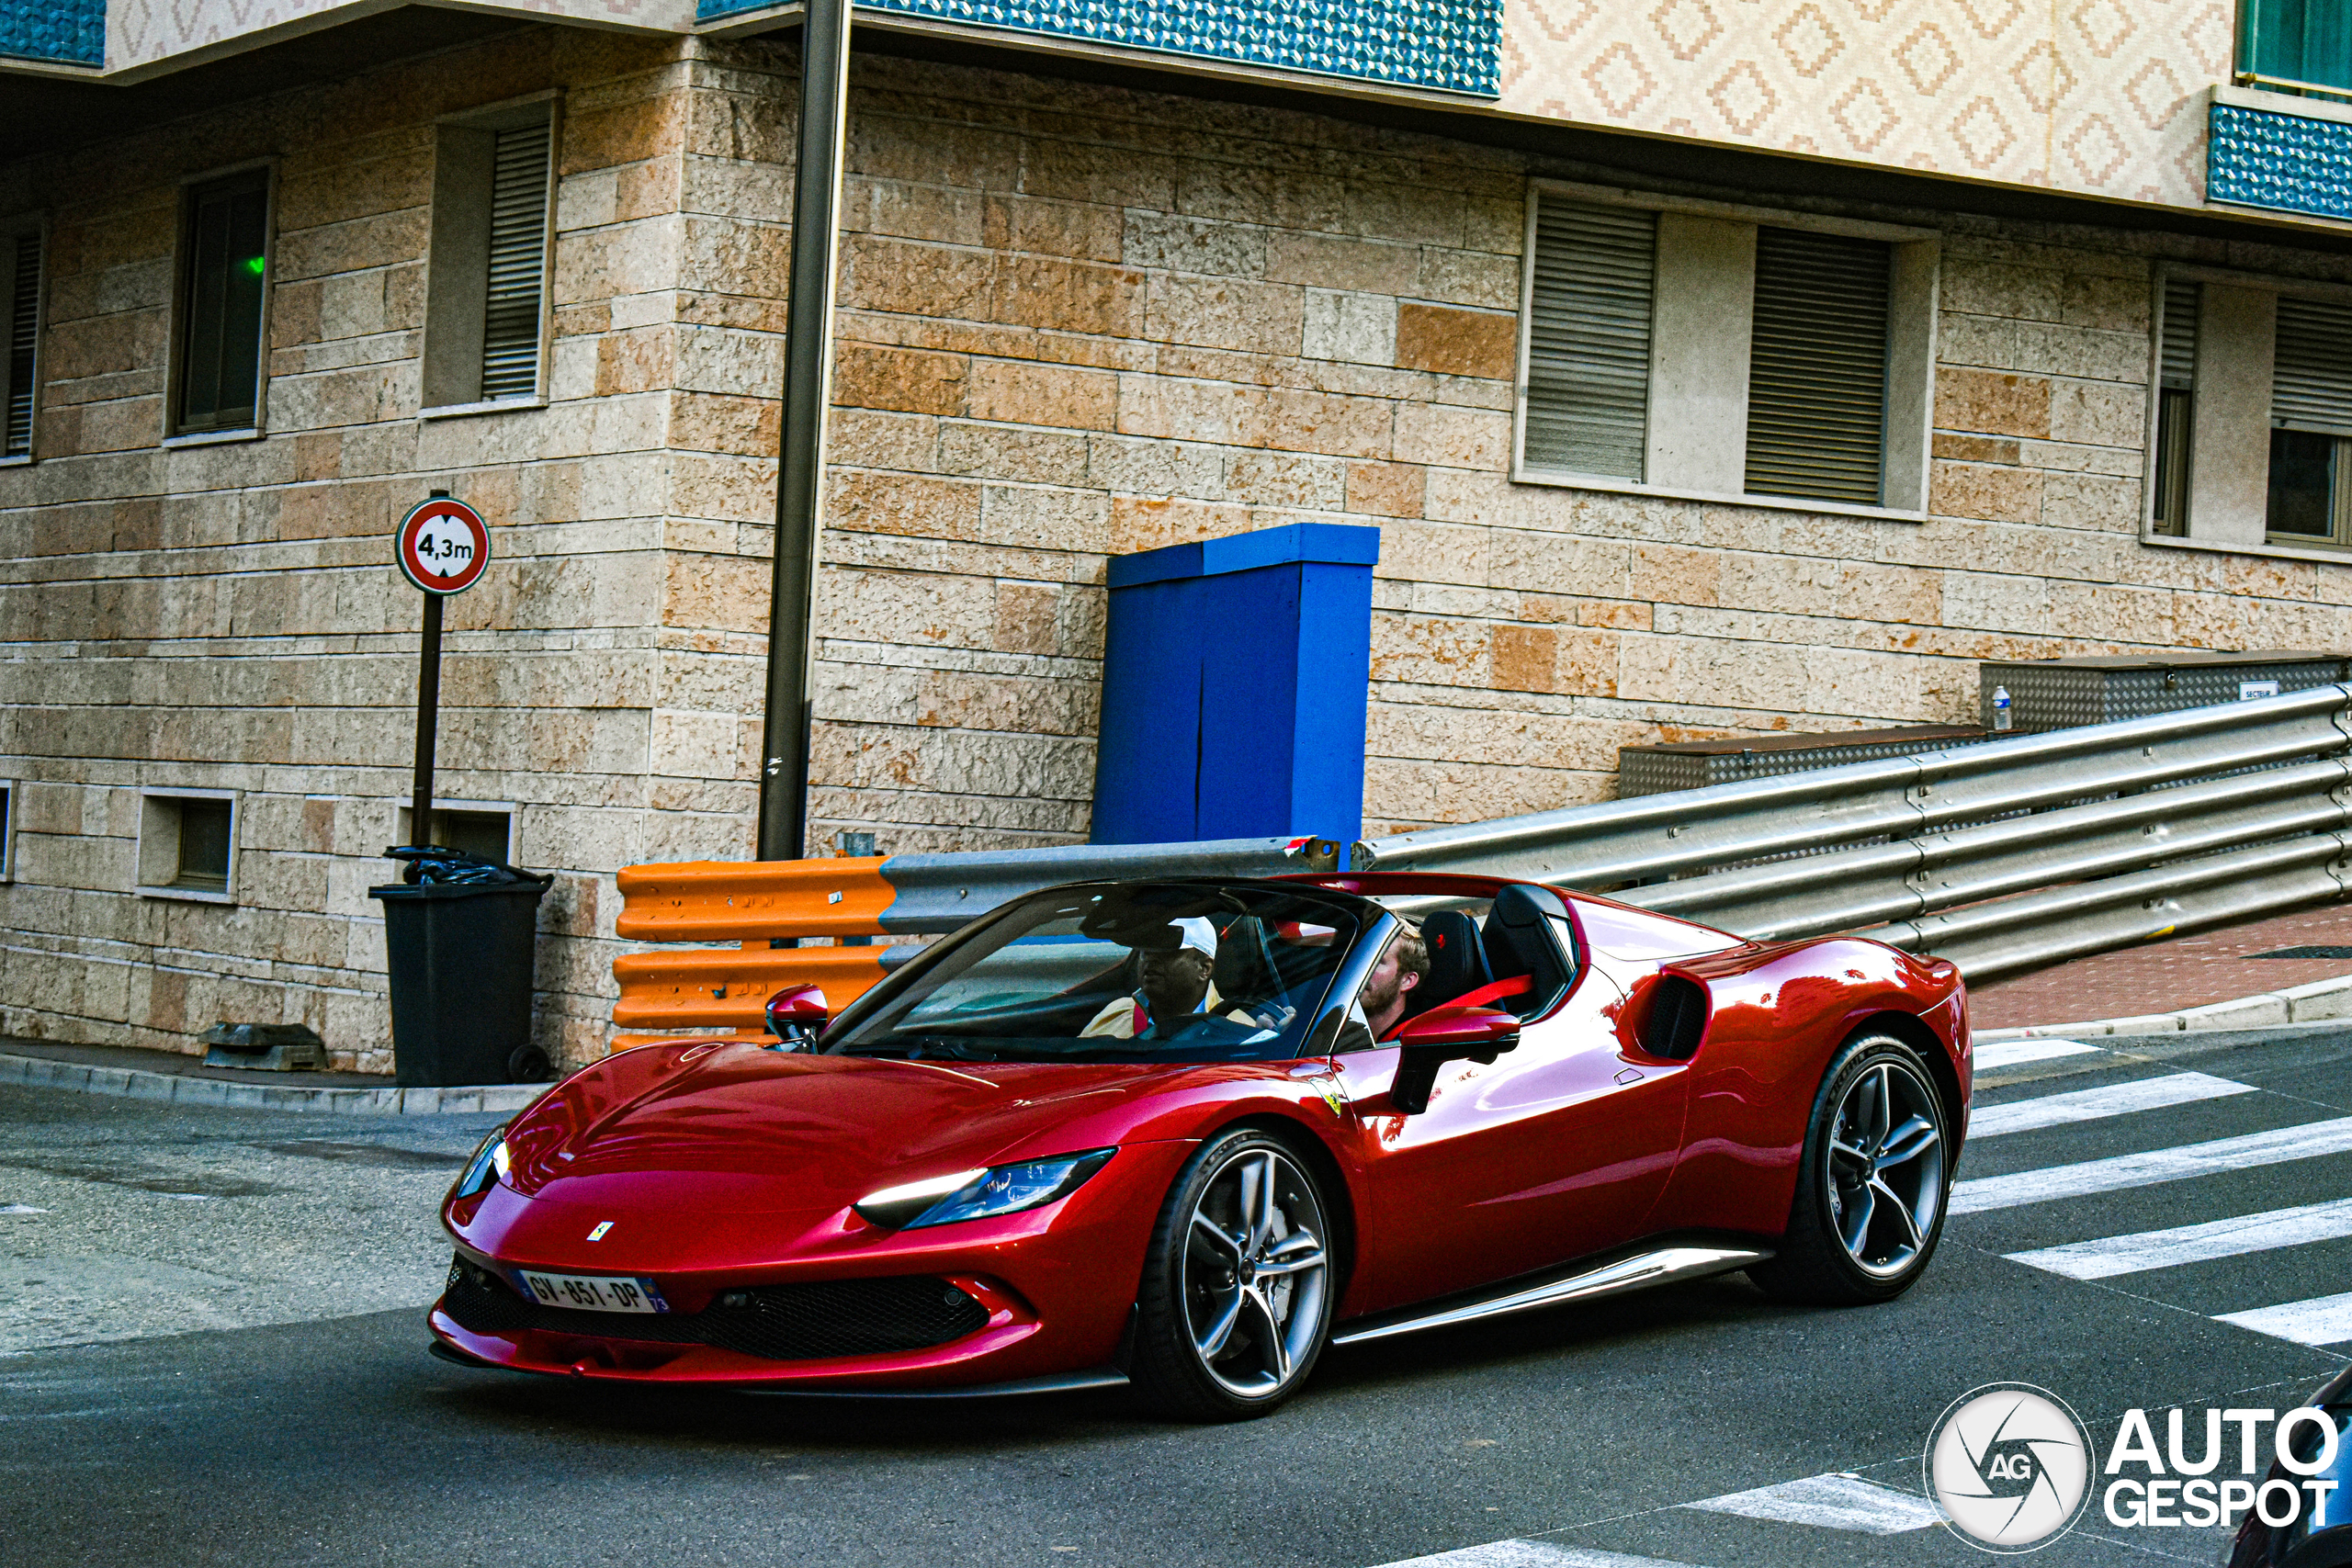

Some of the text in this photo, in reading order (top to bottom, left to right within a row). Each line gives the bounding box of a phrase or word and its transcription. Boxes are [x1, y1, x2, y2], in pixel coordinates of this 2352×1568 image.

[418, 533, 472, 559] 4,3m
[2245, 690, 2270, 698] SECTEUR
[529, 1276, 639, 1308] GV-851-DP
[649, 1298, 669, 1311] 73
